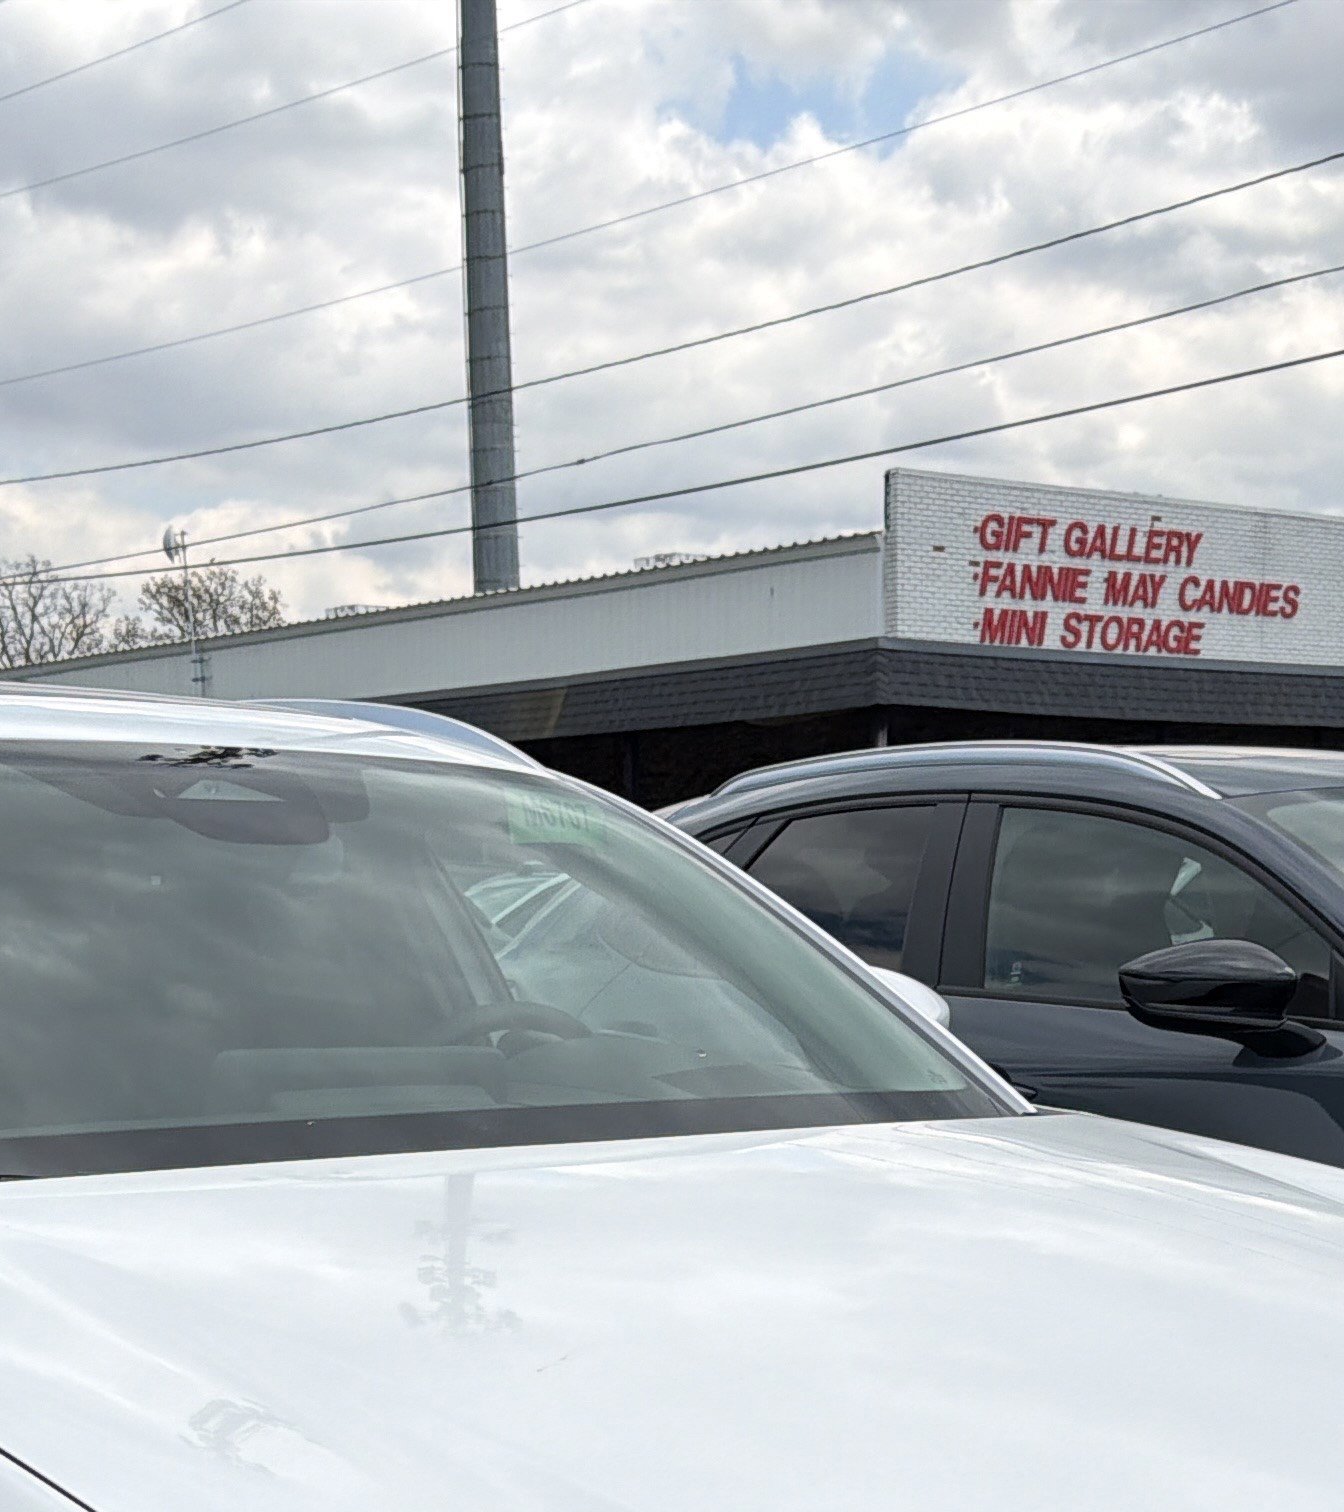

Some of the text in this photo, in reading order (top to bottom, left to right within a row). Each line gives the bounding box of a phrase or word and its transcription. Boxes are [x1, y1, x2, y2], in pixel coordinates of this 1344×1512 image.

[979, 513, 1203, 567] GIFT GALLERY
[979, 560, 1301, 619] FANNIE MAY CANDIES
[980, 607, 1205, 656] MINI STORAGE
